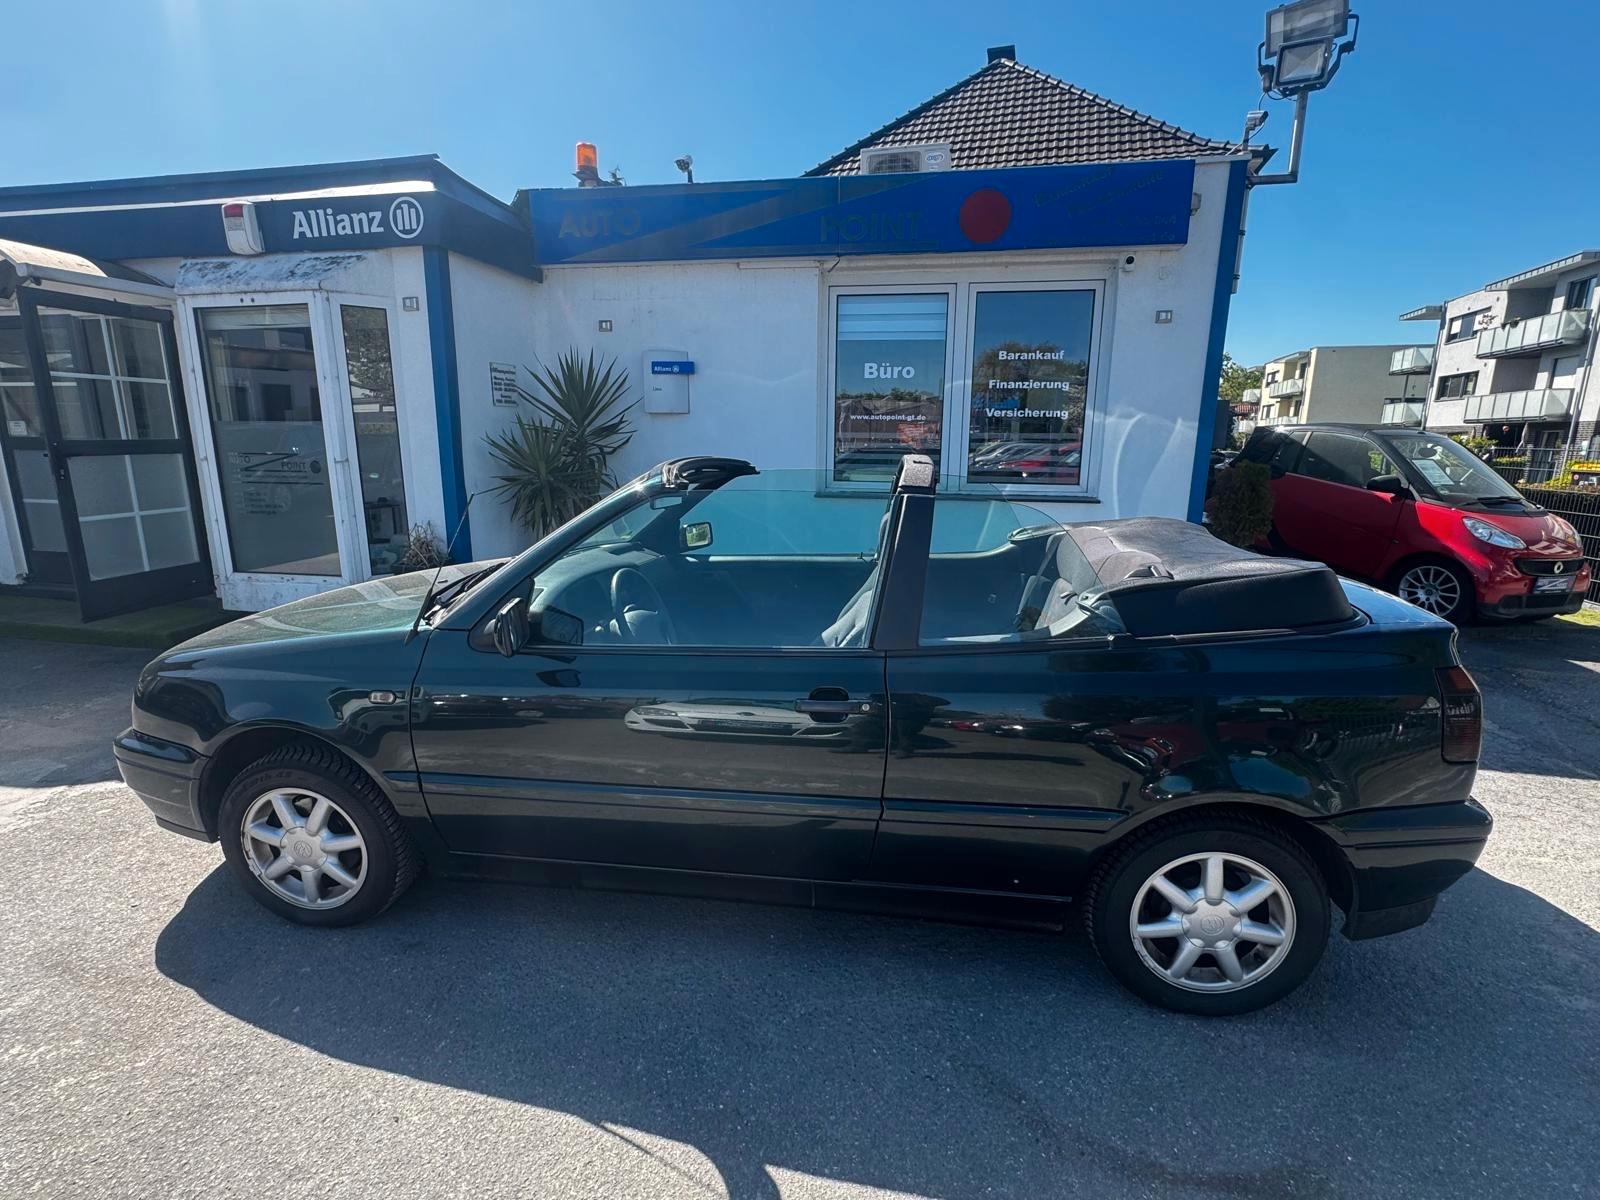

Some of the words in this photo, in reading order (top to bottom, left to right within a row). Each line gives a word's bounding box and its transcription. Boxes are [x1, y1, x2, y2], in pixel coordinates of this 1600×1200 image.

[292, 207, 384, 239] Allianz
[558, 208, 641, 239] AUTO
[820, 210, 924, 242] POINT
[998, 349, 1065, 361] Barankauf
[864, 362, 915, 379] Büro
[989, 379, 1070, 391] Finanzierung
[850, 413, 926, 422] www.autopoint-gt.de
[985, 407, 1069, 420] Versicherung
